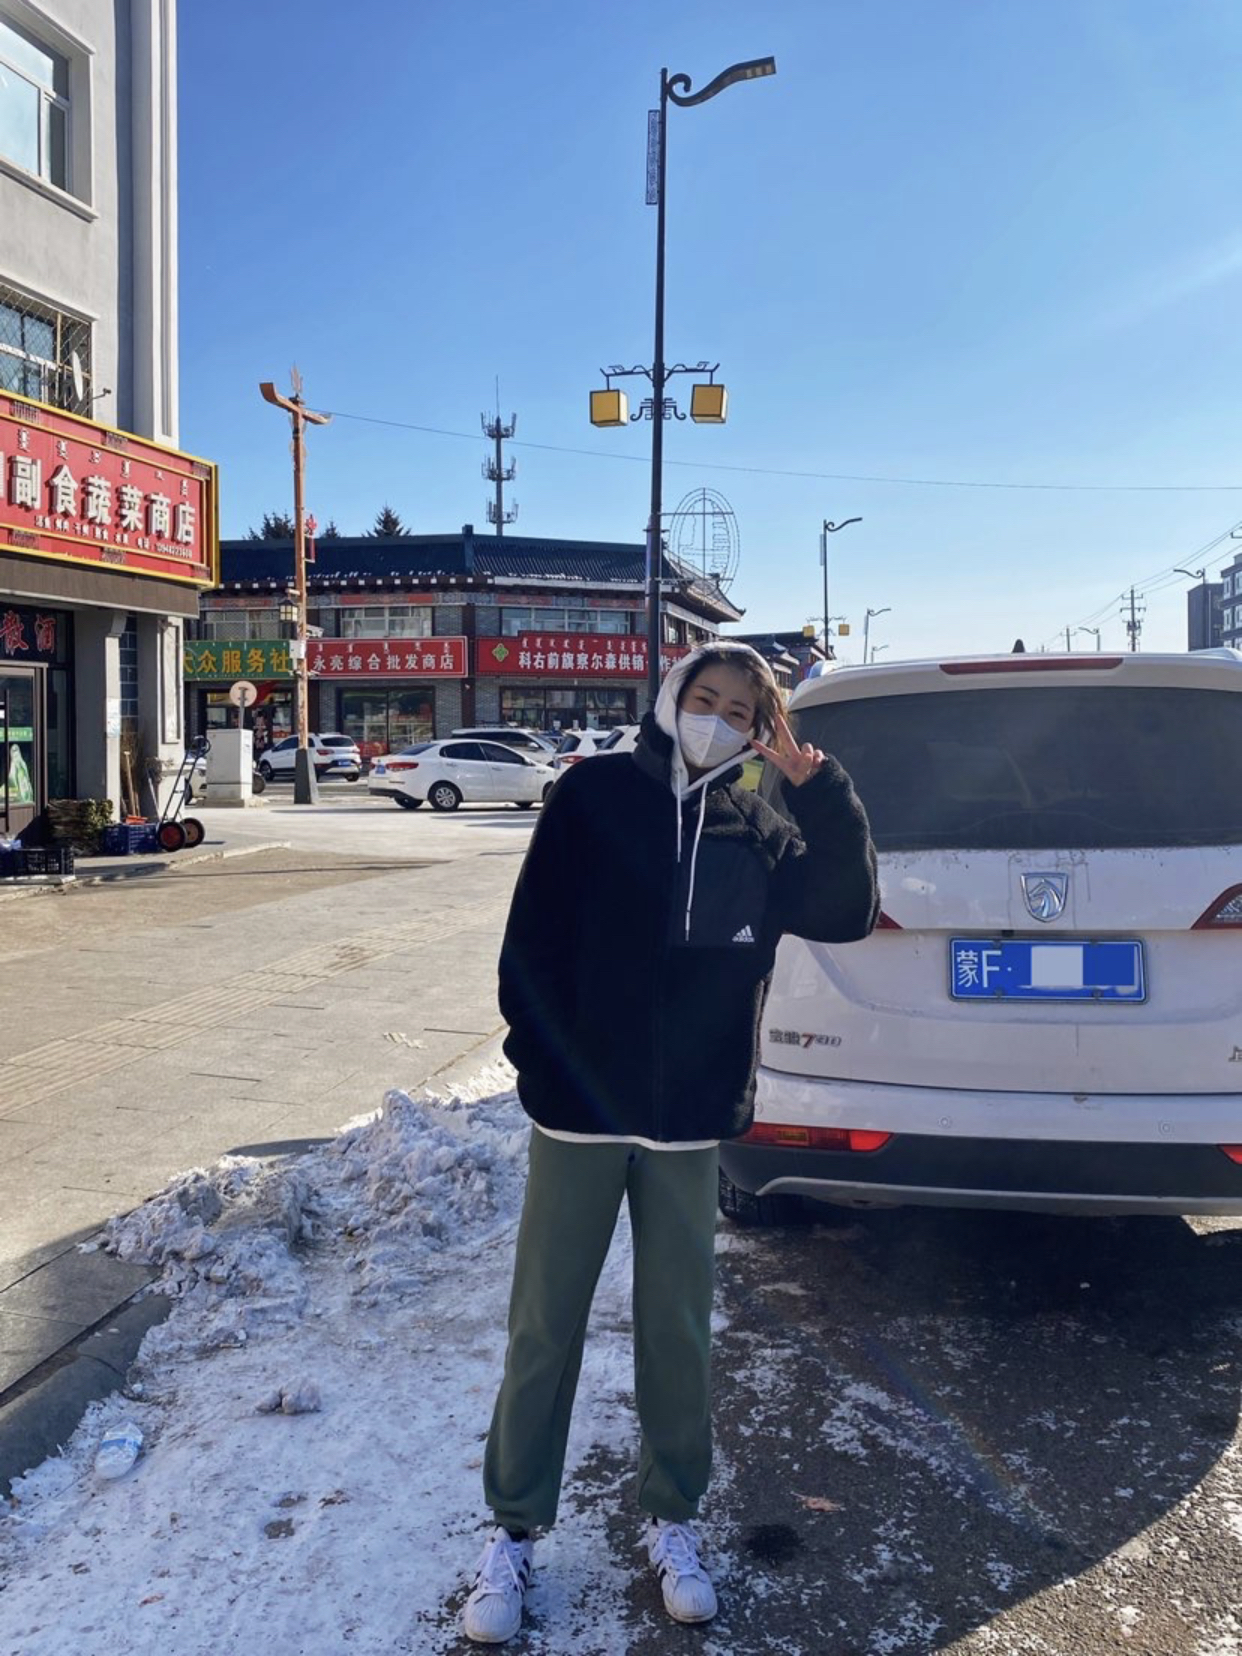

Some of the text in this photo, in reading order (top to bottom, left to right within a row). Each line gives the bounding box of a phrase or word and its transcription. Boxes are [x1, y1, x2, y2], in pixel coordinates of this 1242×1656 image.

[0, 451, 195, 546] 副食蔬菜商店
[313, 653, 454, 671] 永亮综合批发商店
